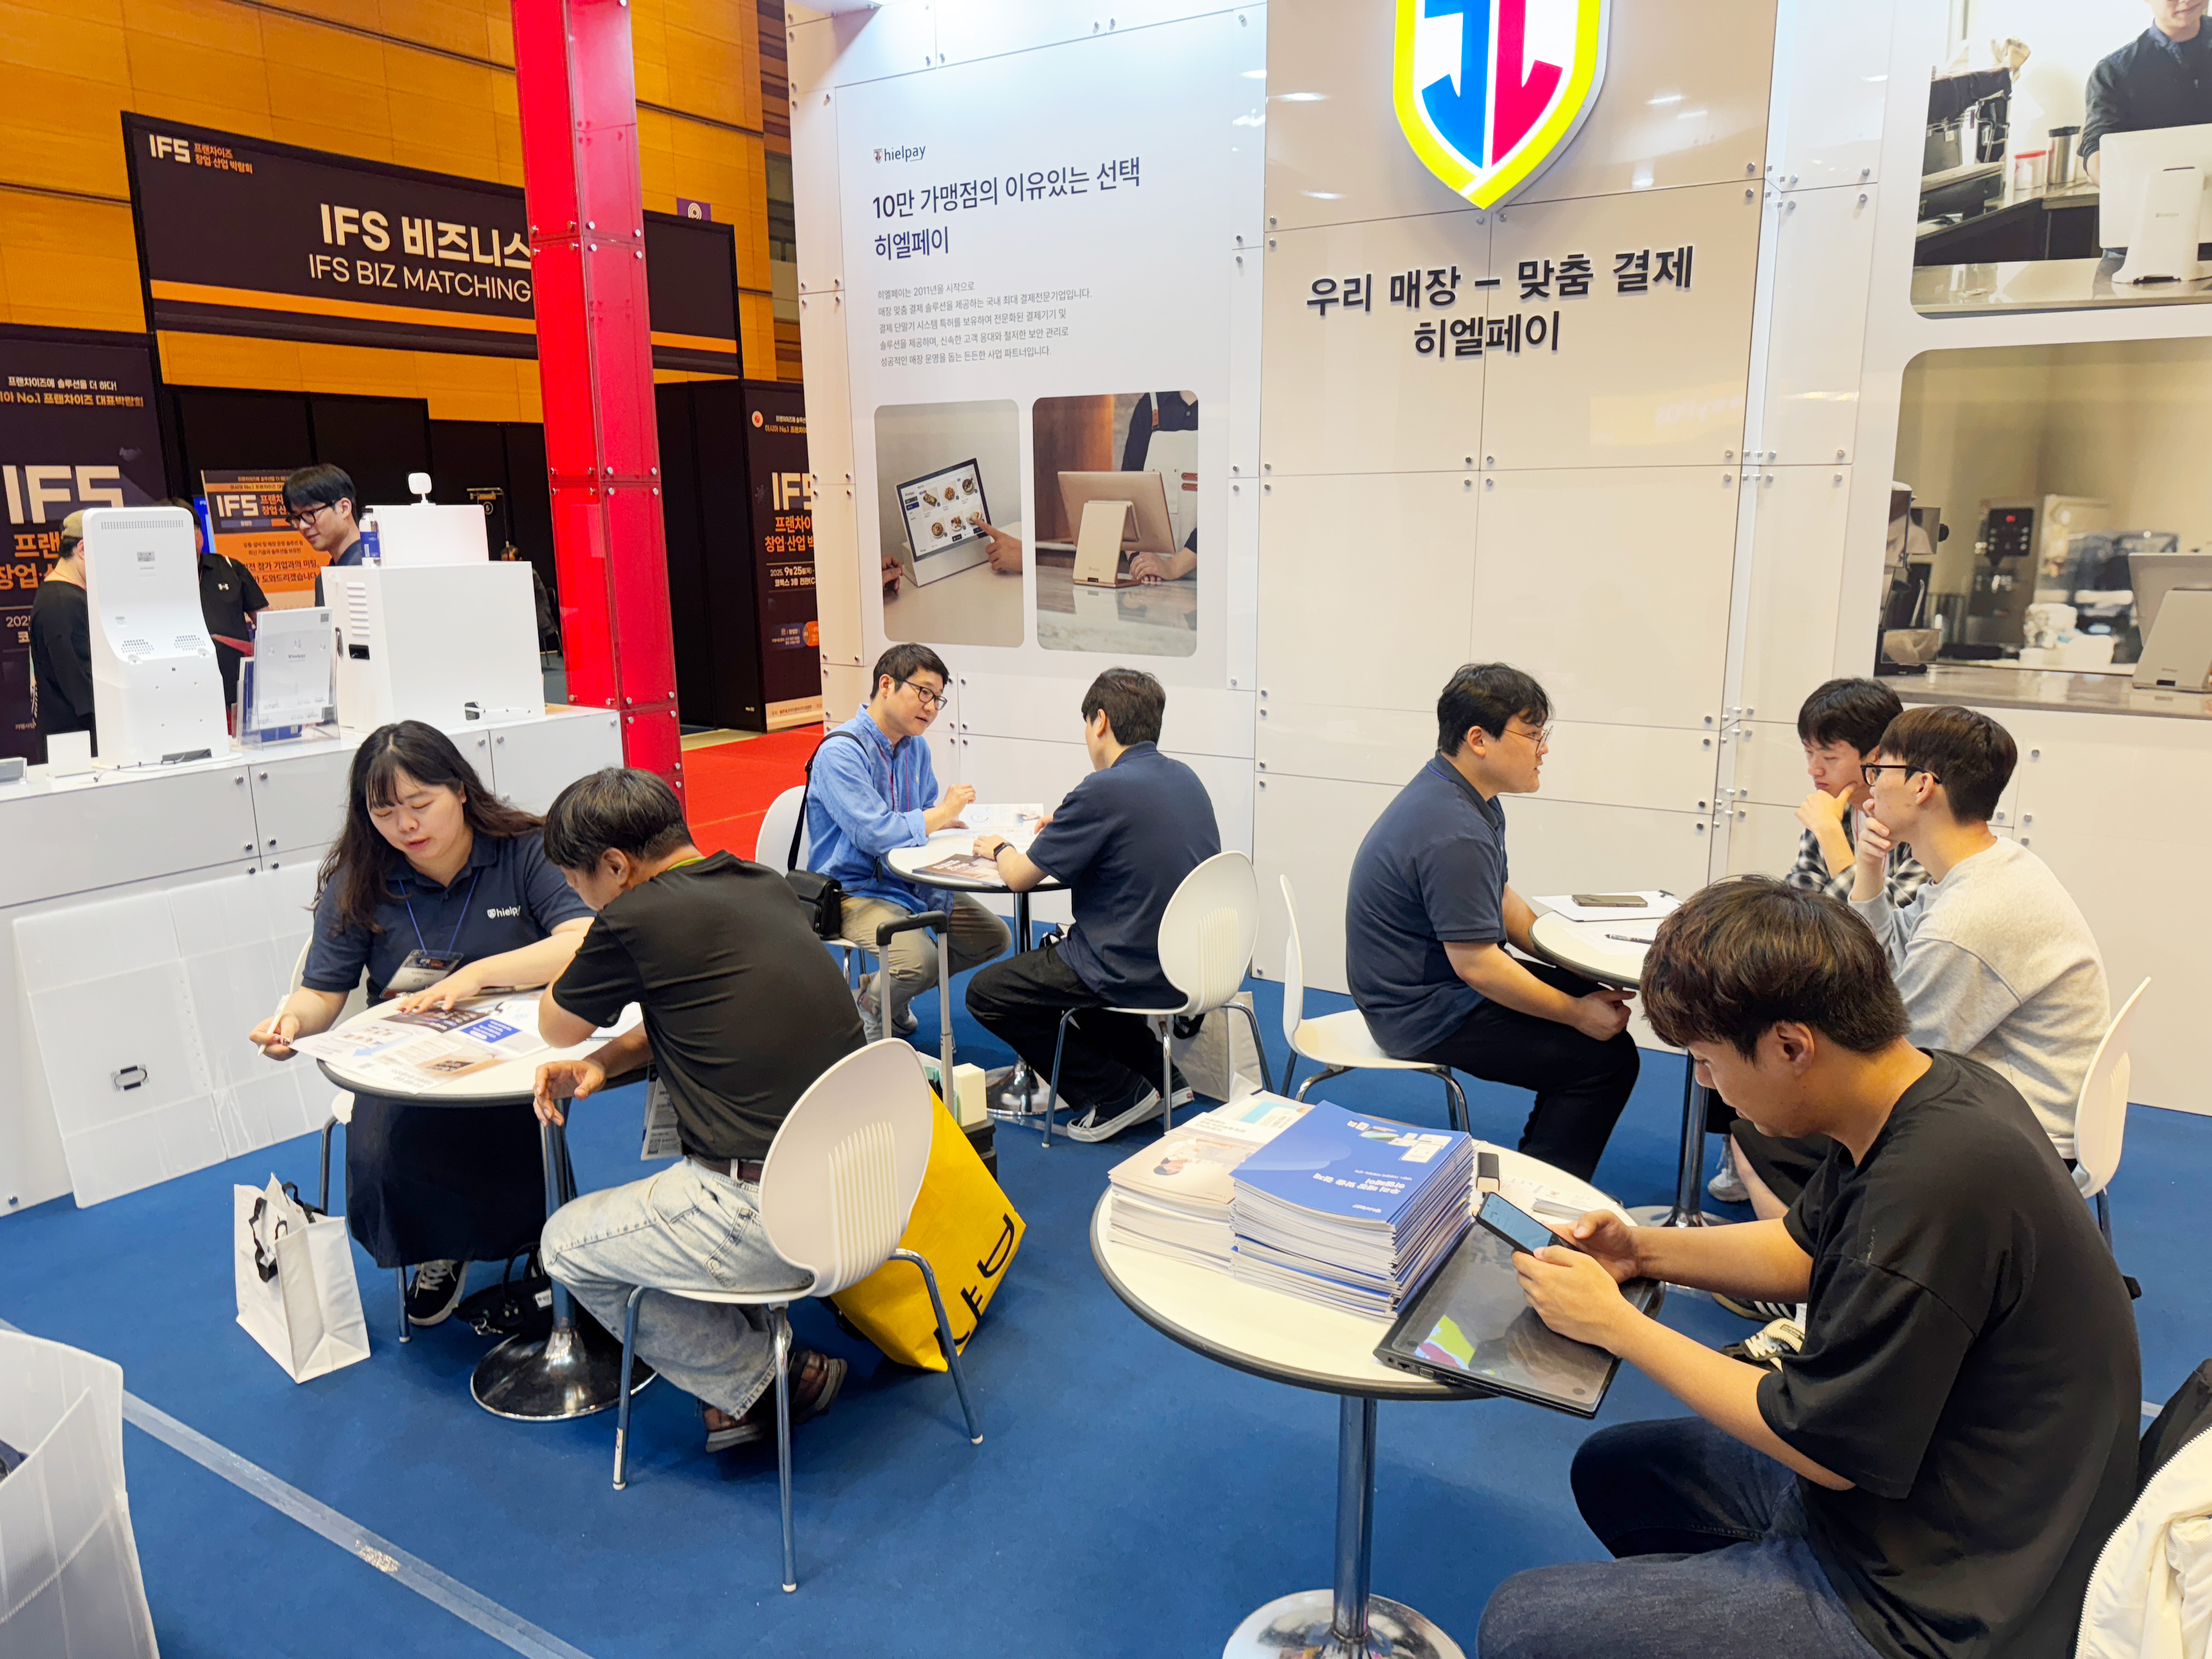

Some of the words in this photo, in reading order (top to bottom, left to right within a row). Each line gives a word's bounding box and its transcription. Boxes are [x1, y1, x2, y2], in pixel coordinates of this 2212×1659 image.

[149, 134, 190, 163] IFS
[884, 146, 926, 162] hielpay
[873, 189, 915, 218] 10만
[921, 177, 997, 213] 가맹점의
[1006, 167, 1090, 202] 이유있는
[1097, 156, 1140, 191] 선택
[320, 204, 390, 252] IFS
[875, 227, 949, 260] 히엘페이
[309, 253, 350, 281] IFS
[357, 261, 398, 289] BIZ
[404, 266, 531, 302] MATCHING
[878, 289, 911, 299] 히엘페이는
[913, 284, 944, 297] 2011년을
[946, 281, 974, 294] 시작으로
[1307, 274, 1372, 315] 우리
[1390, 266, 1461, 308] 매장
[1518, 253, 1593, 299] 맞춤
[1613, 246, 1693, 292] 결제
[878, 306, 891, 317] 매장
[894, 305, 907, 315] 맞춤
[910, 303, 923, 314] 결제
[925, 301, 952, 313] 솔루션을
[956, 298, 984, 310] 제공하는
[987, 297, 1001, 307] 국내
[1003, 295, 1018, 305] 최대
[1020, 288, 1092, 303] 결제전문기업입니다.
[879, 323, 892, 334] 결제
[894, 321, 915, 333] 단말기
[917, 319, 937, 330] 시스템
[940, 317, 961, 329] 특허를
[963, 314, 992, 326] 보유하여
[994, 311, 1023, 324] 전문화된
[1026, 308, 1056, 321] 결제기기
[1059, 308, 1066, 319] 및
[1414, 311, 1559, 358] 히엘페이
[880, 338, 906, 351] 솔루션을
[909, 336, 939, 348] 제공하며,
[940, 334, 962, 346] 신속한
[964, 333, 978, 344] 고객
[980, 331, 1001, 343] 응대와
[1004, 329, 1026, 341] 철저한
[1028, 328, 1043, 338] 보안
[1046, 326, 1069, 337] 관리로
[881, 355, 907, 367] 성공적인
[910, 353, 923, 365] 매장
[925, 352, 946, 364] 운영을
[948, 351, 962, 362] 돕는
[964, 349, 985, 361] 든든한
[988, 348, 1002, 359] 사업
[1004, 346, 1051, 358] 파트너입니다.
[17, 392, 41, 404] No.1
[2, 466, 124, 524] IFS
[216, 495, 258, 517] IFS
[6, 616, 31, 627] 202
[496, 905, 521, 917] hielp
